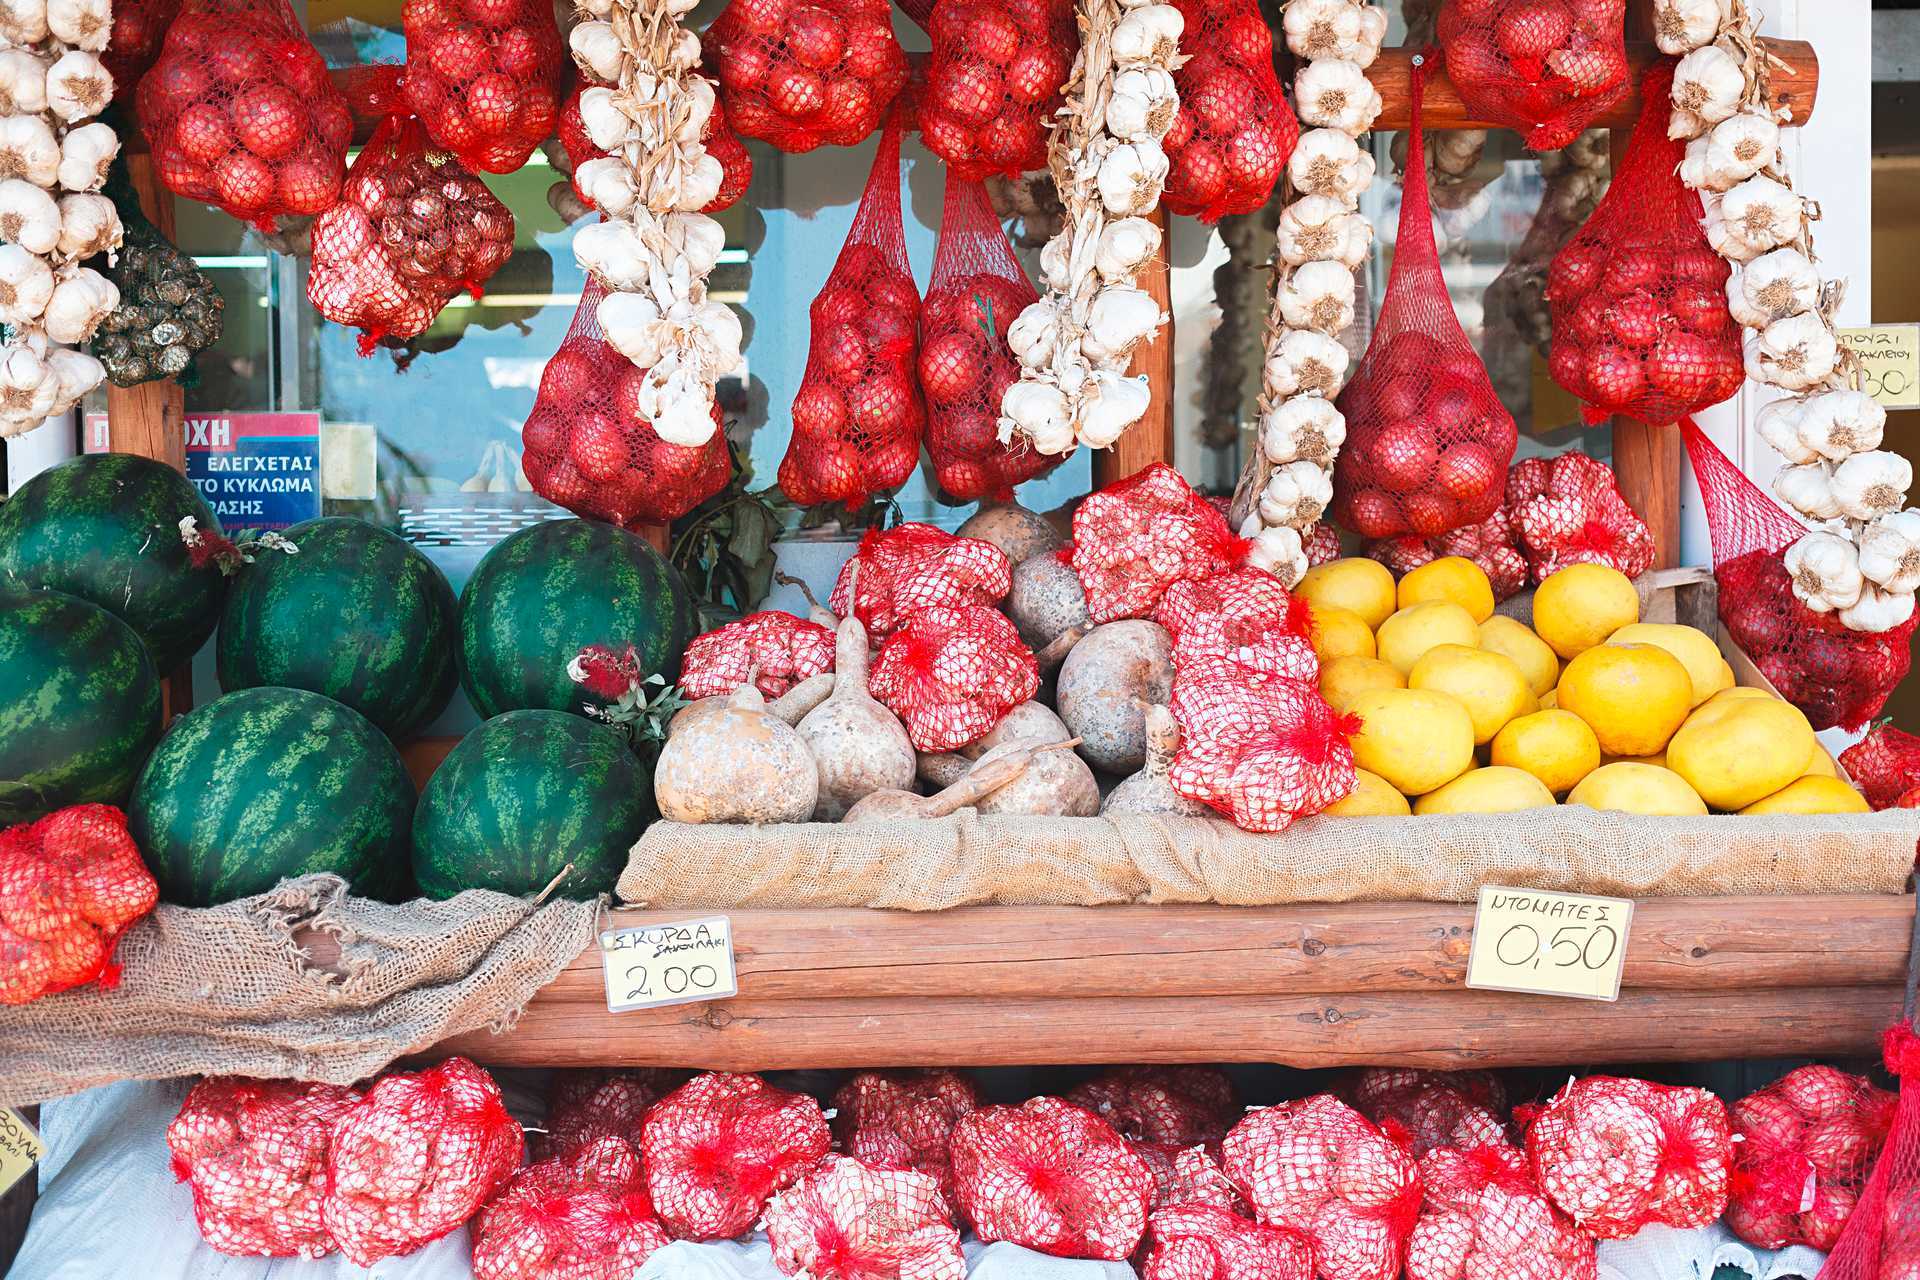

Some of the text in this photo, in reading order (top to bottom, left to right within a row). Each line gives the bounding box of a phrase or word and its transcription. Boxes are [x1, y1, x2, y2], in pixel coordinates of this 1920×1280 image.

[207, 456, 313, 471] ΕΛΕΓΧΕΤΑΙ
[223, 478, 313, 493] ΚΥΚΛΩΜΑ
[1496, 923, 1617, 970] 0,50
[625, 964, 717, 1000] 2,00
